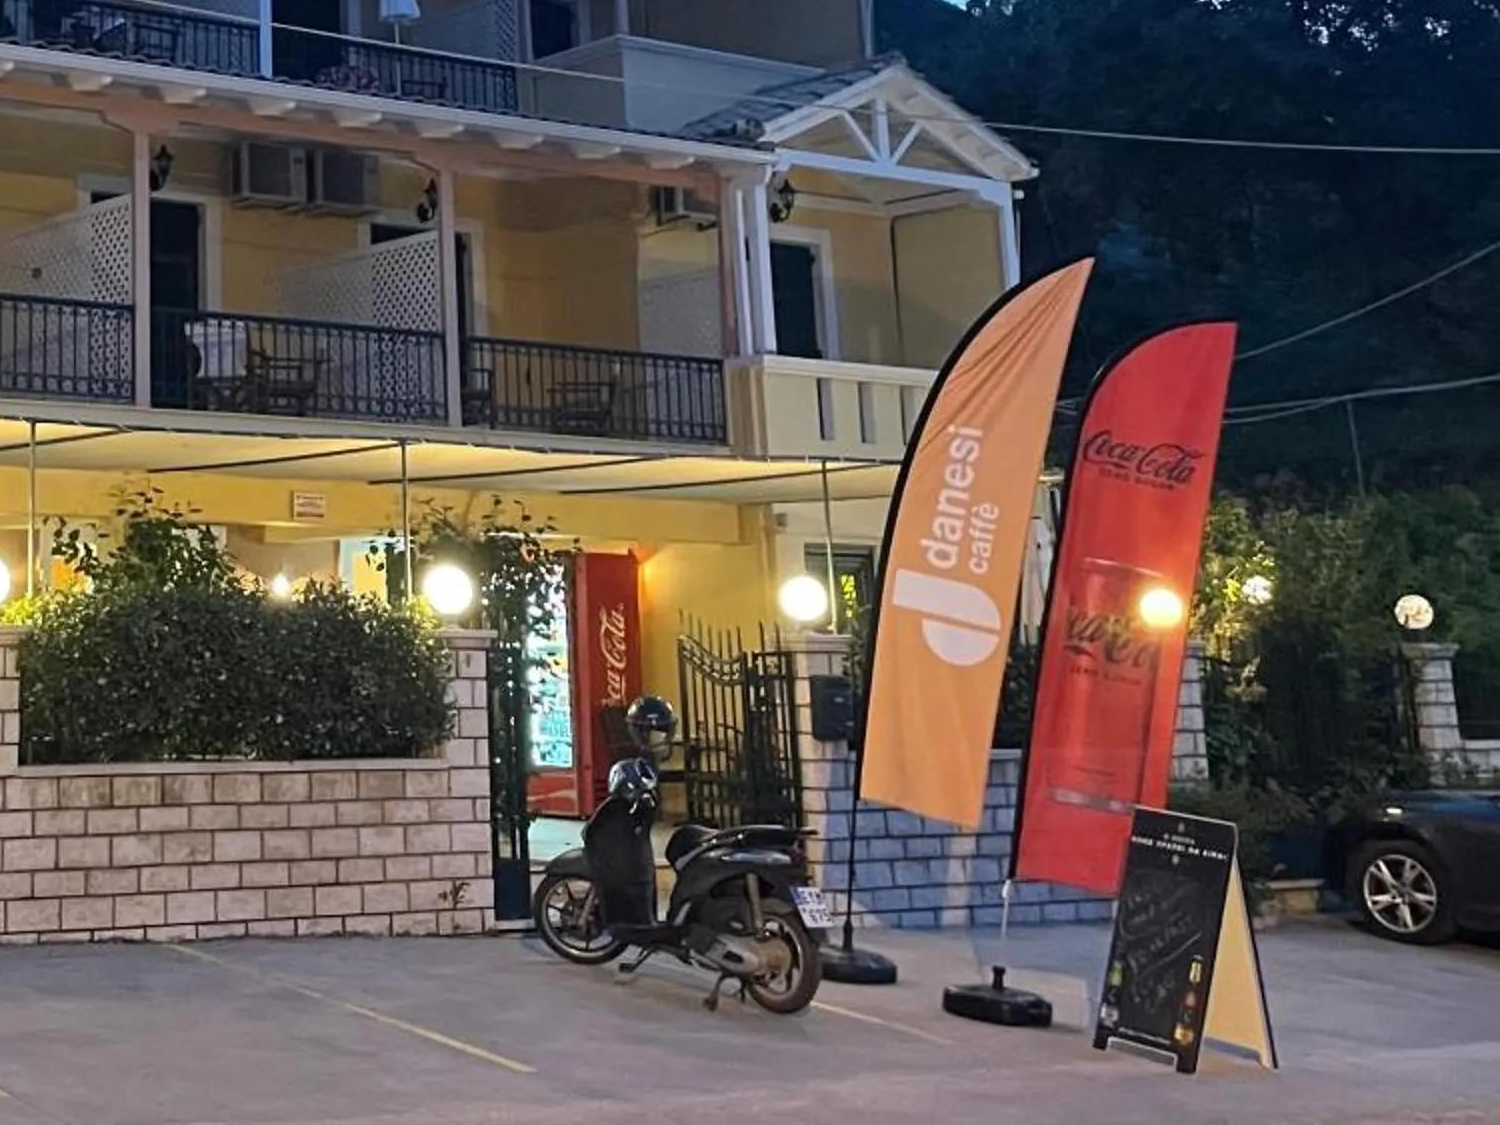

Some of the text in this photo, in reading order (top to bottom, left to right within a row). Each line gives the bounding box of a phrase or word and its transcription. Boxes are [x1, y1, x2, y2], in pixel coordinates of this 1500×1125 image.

[1082, 429, 1204, 484] Coca-Cola
[920, 425, 984, 569] danesi
[968, 502, 999, 574] caffè
